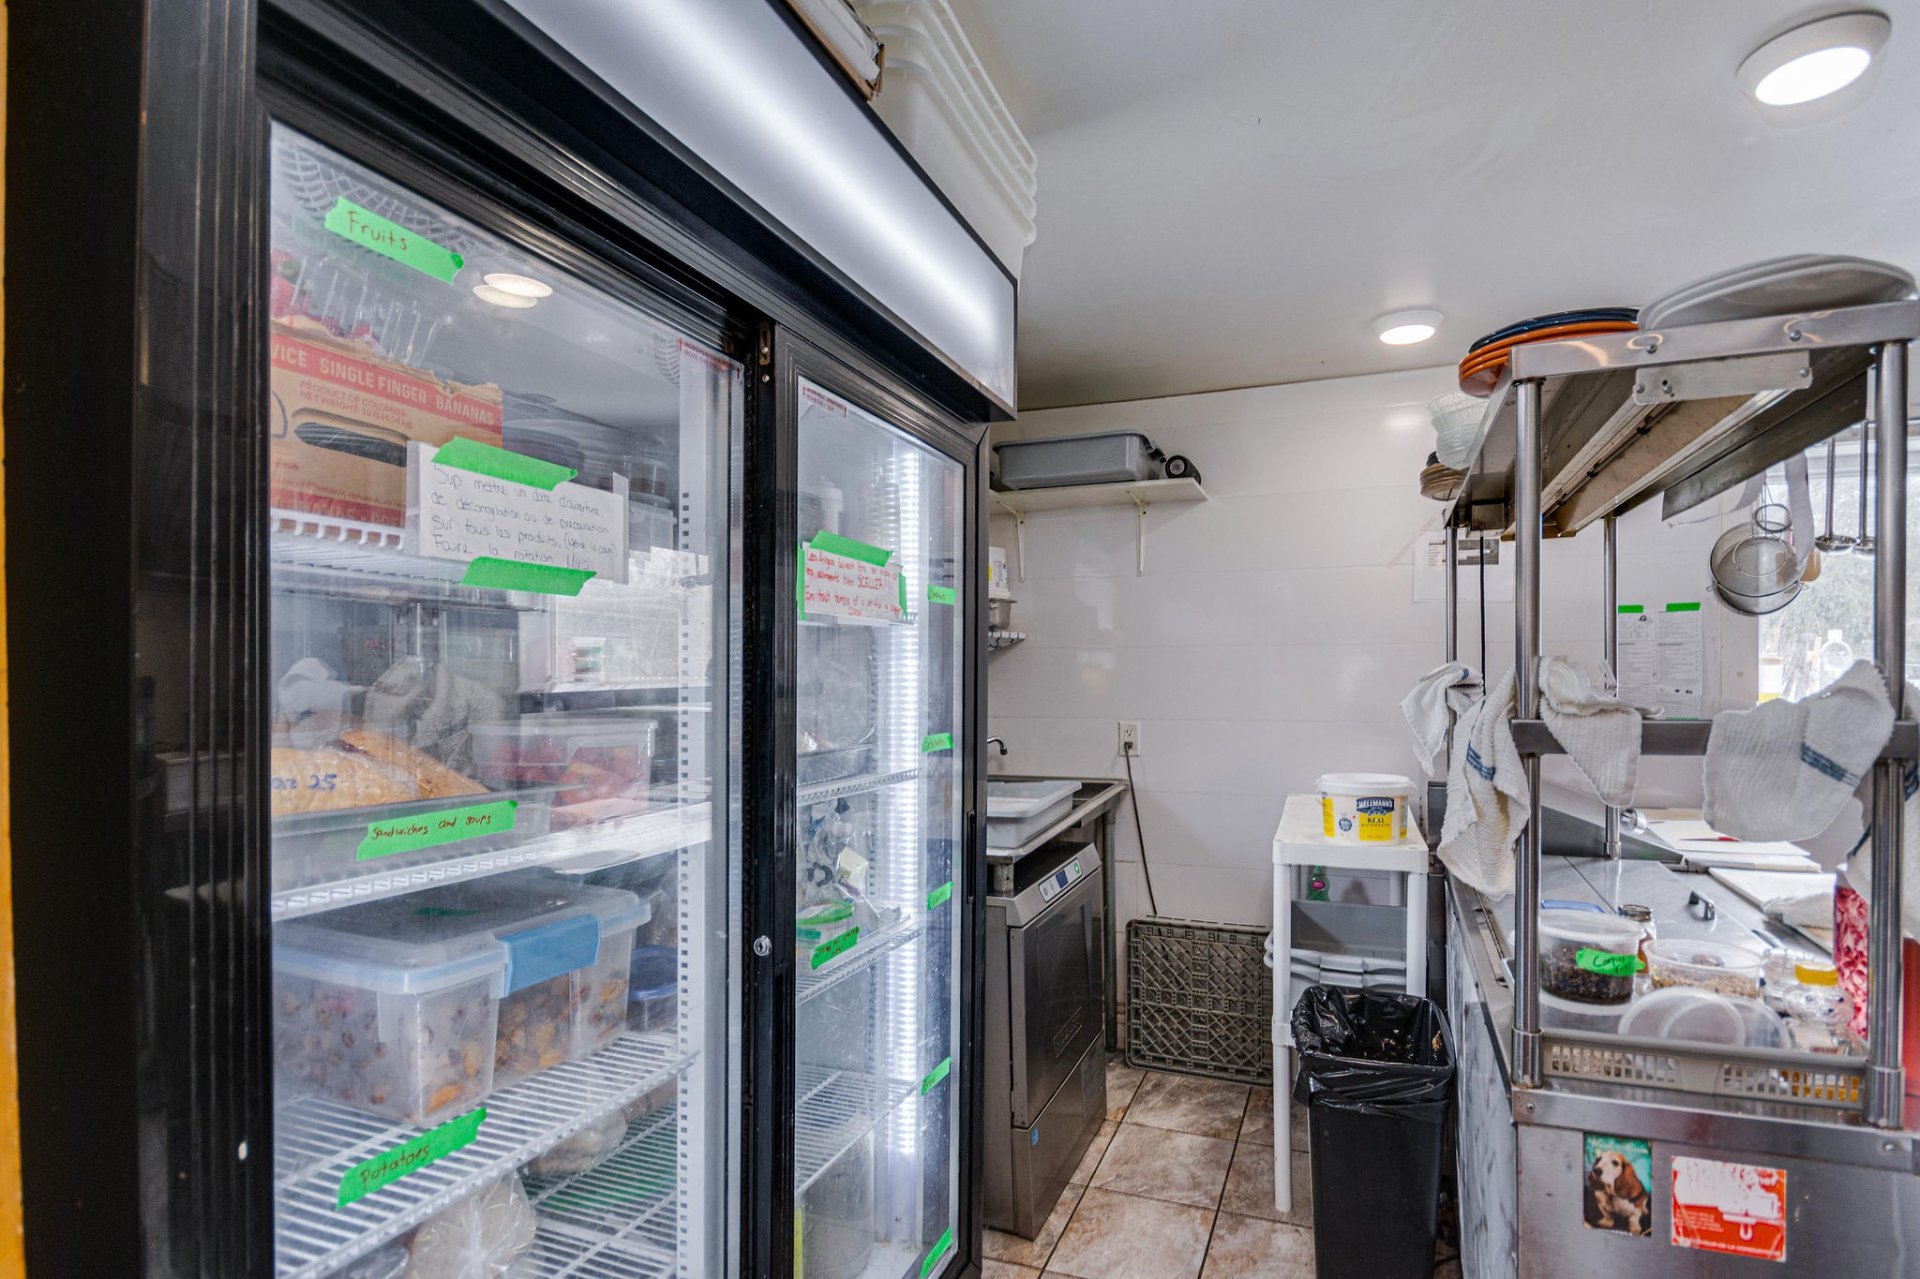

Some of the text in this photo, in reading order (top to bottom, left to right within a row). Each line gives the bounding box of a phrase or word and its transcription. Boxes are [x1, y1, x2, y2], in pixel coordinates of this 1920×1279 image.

[347, 210, 407, 251] Fruits
[319, 357, 374, 389] SINGLE
[378, 374, 427, 405] FINGER
[435, 394, 495, 425] BANANAS
[465, 519, 490, 536] tous
[371, 825, 429, 841] Sandwiches
[438, 816, 457, 830] and
[359, 1145, 429, 1189] Potatoes
